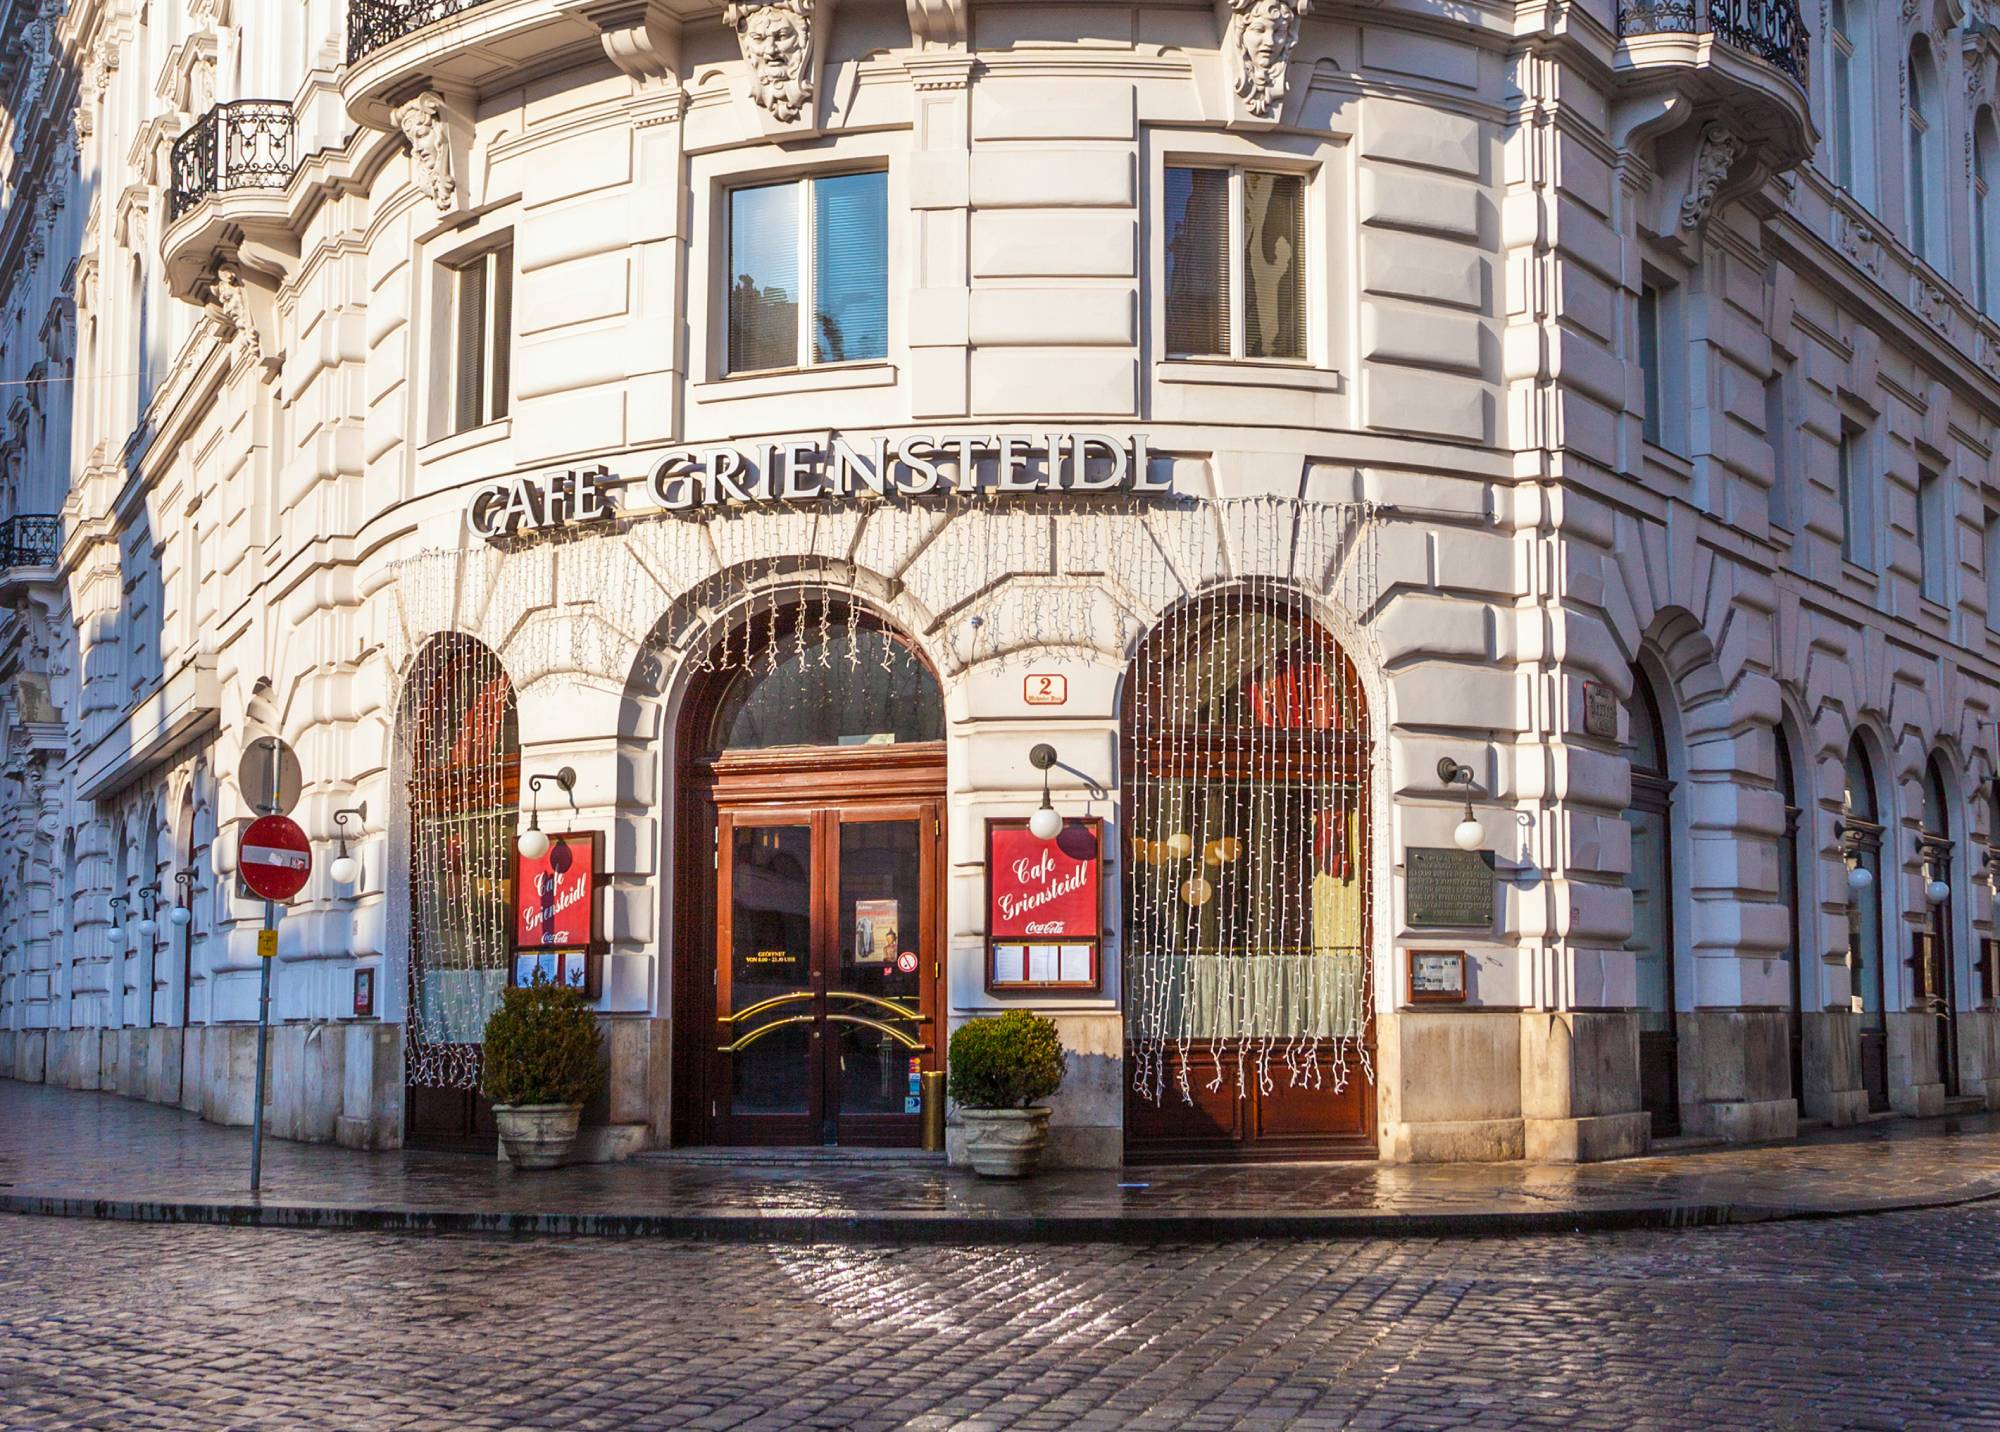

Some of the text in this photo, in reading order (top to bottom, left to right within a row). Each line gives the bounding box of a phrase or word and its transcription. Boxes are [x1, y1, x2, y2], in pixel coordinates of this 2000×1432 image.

[466, 433, 1172, 539] CAFE GRIENSTEIDL
[1039, 677, 1052, 695] 2
[534, 864, 564, 897] Cafe
[1012, 848, 1056, 884] Cafe
[523, 873, 587, 932] Griensteidl
[998, 860, 1088, 920] Griensteidl
